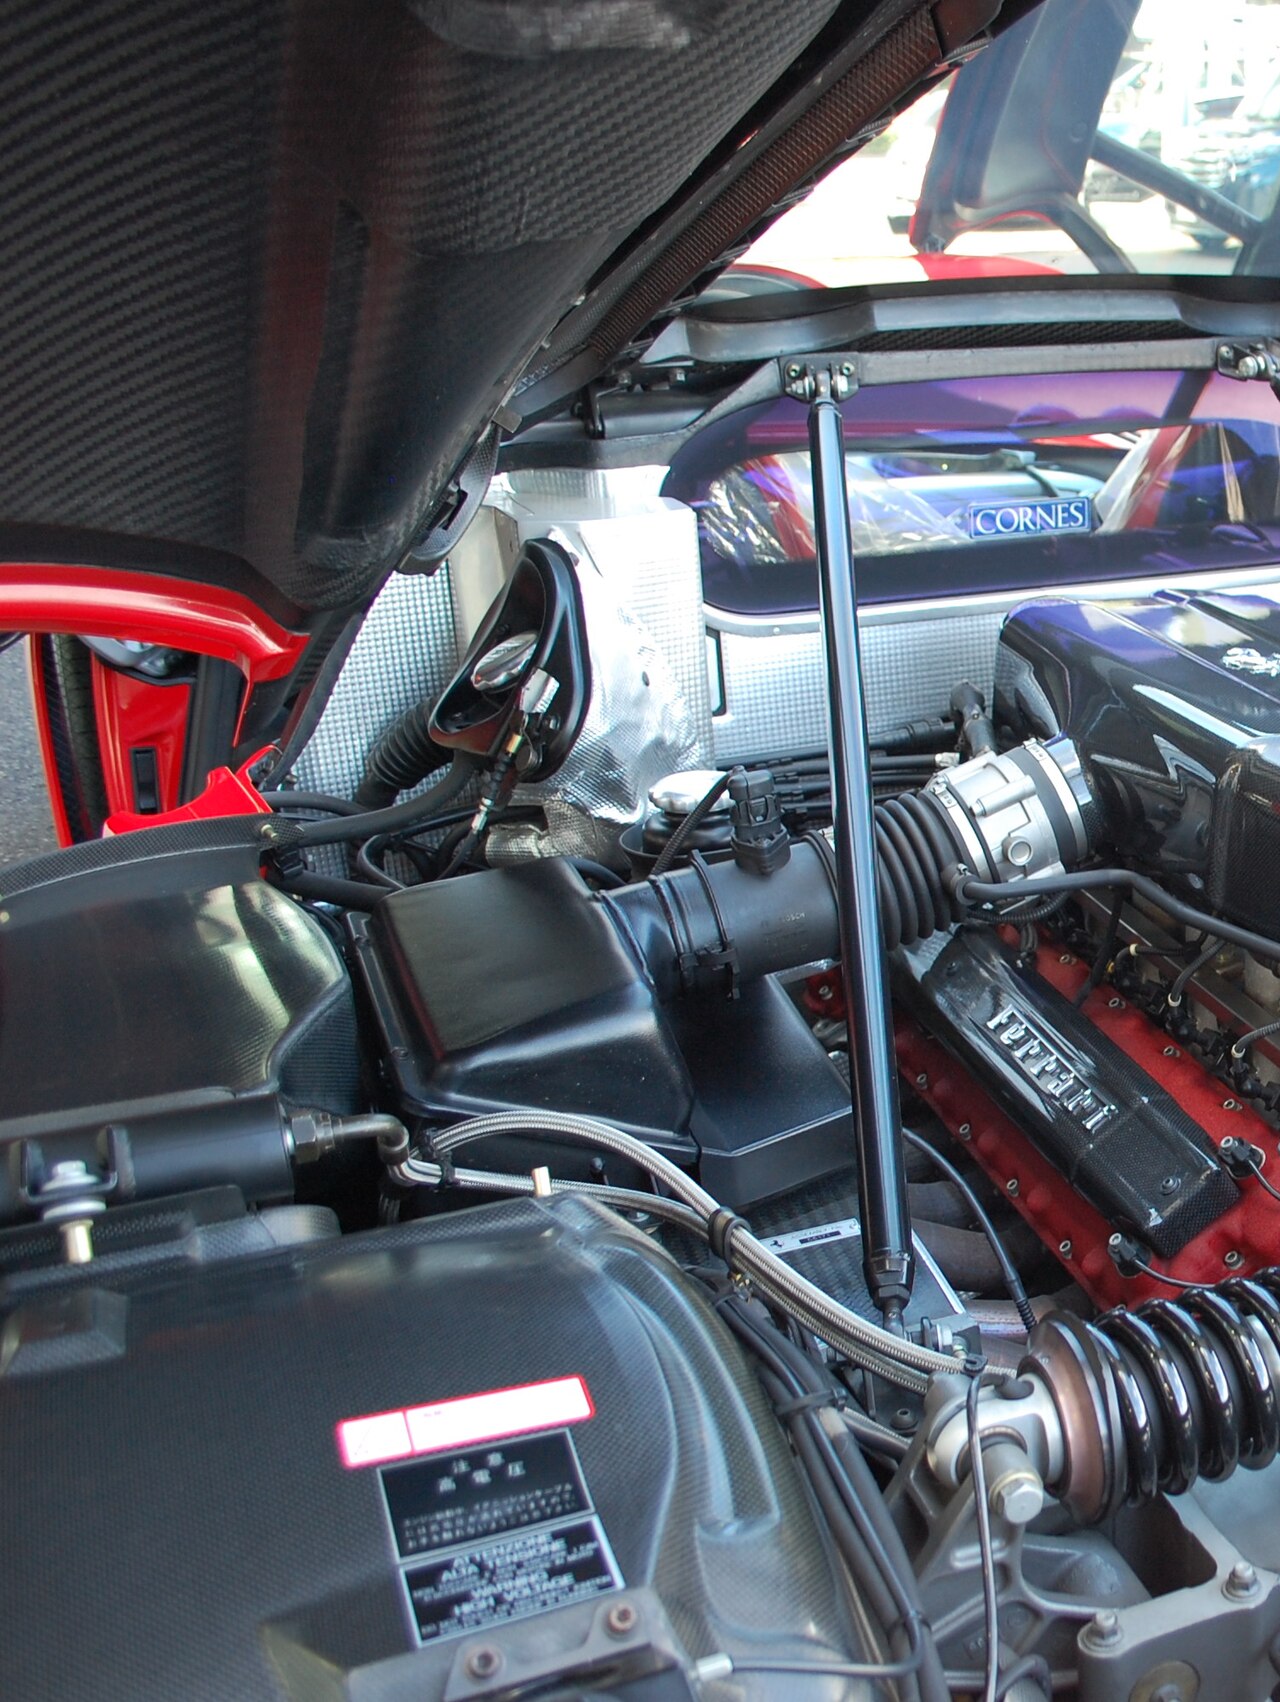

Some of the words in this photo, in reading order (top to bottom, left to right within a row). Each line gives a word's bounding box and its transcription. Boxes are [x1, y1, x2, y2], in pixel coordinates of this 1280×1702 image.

[976, 502, 1083, 534] CORNES
[986, 1003, 1118, 1133] Ferrari
[441, 1562, 479, 1581] ALTA
[487, 1539, 567, 1568] TENSIONE
[452, 1533, 553, 1567] ATTENZIONE
[454, 1595, 494, 1616] HIGH
[503, 1573, 576, 1602] VOLTAGE
[471, 1569, 549, 1599] WARNING
